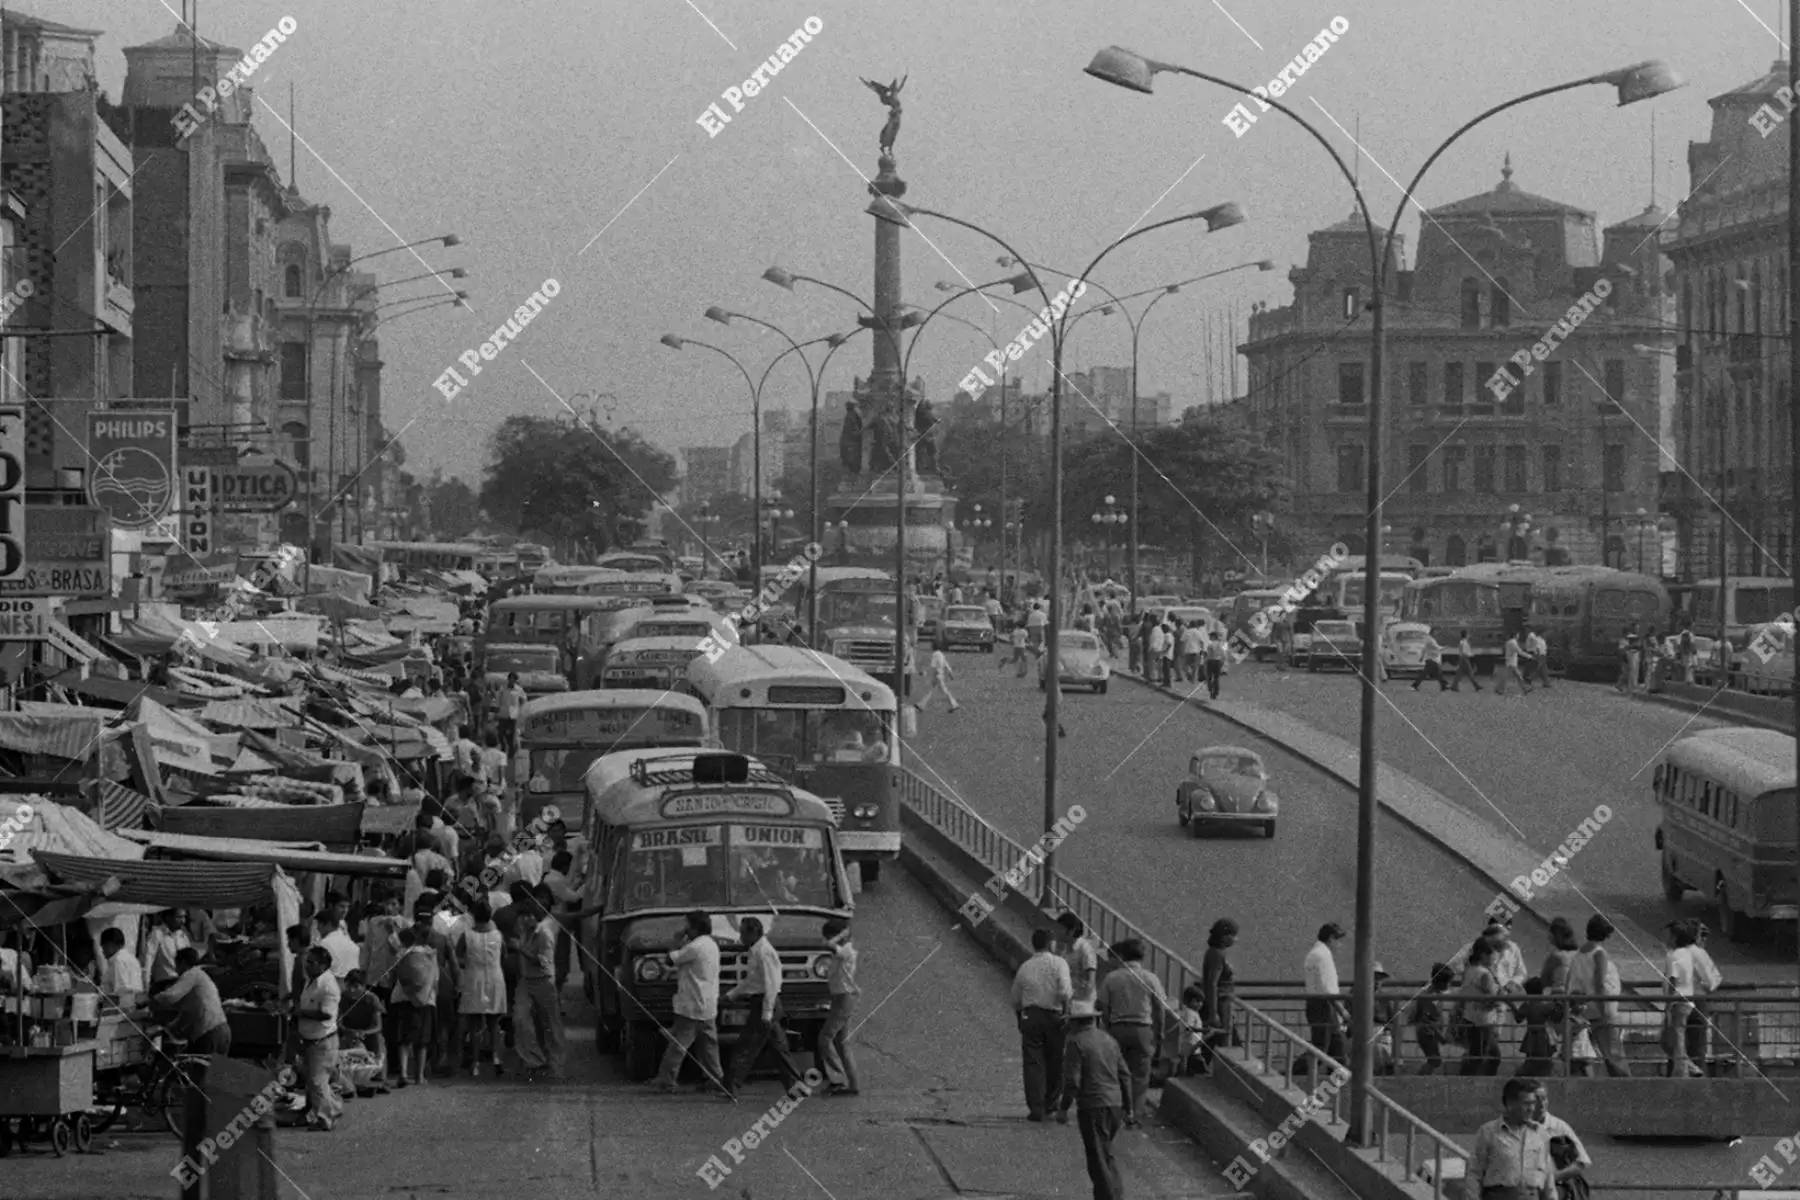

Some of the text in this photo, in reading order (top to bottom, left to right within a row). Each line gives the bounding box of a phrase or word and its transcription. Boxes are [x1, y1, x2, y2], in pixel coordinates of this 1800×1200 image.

[95, 420, 167, 439] PHILIPS
[188, 471, 208, 553] UNION
[51, 569, 104, 591] BRASA
[640, 826, 713, 848] BRASIL
[745, 827, 805, 844] UNION
